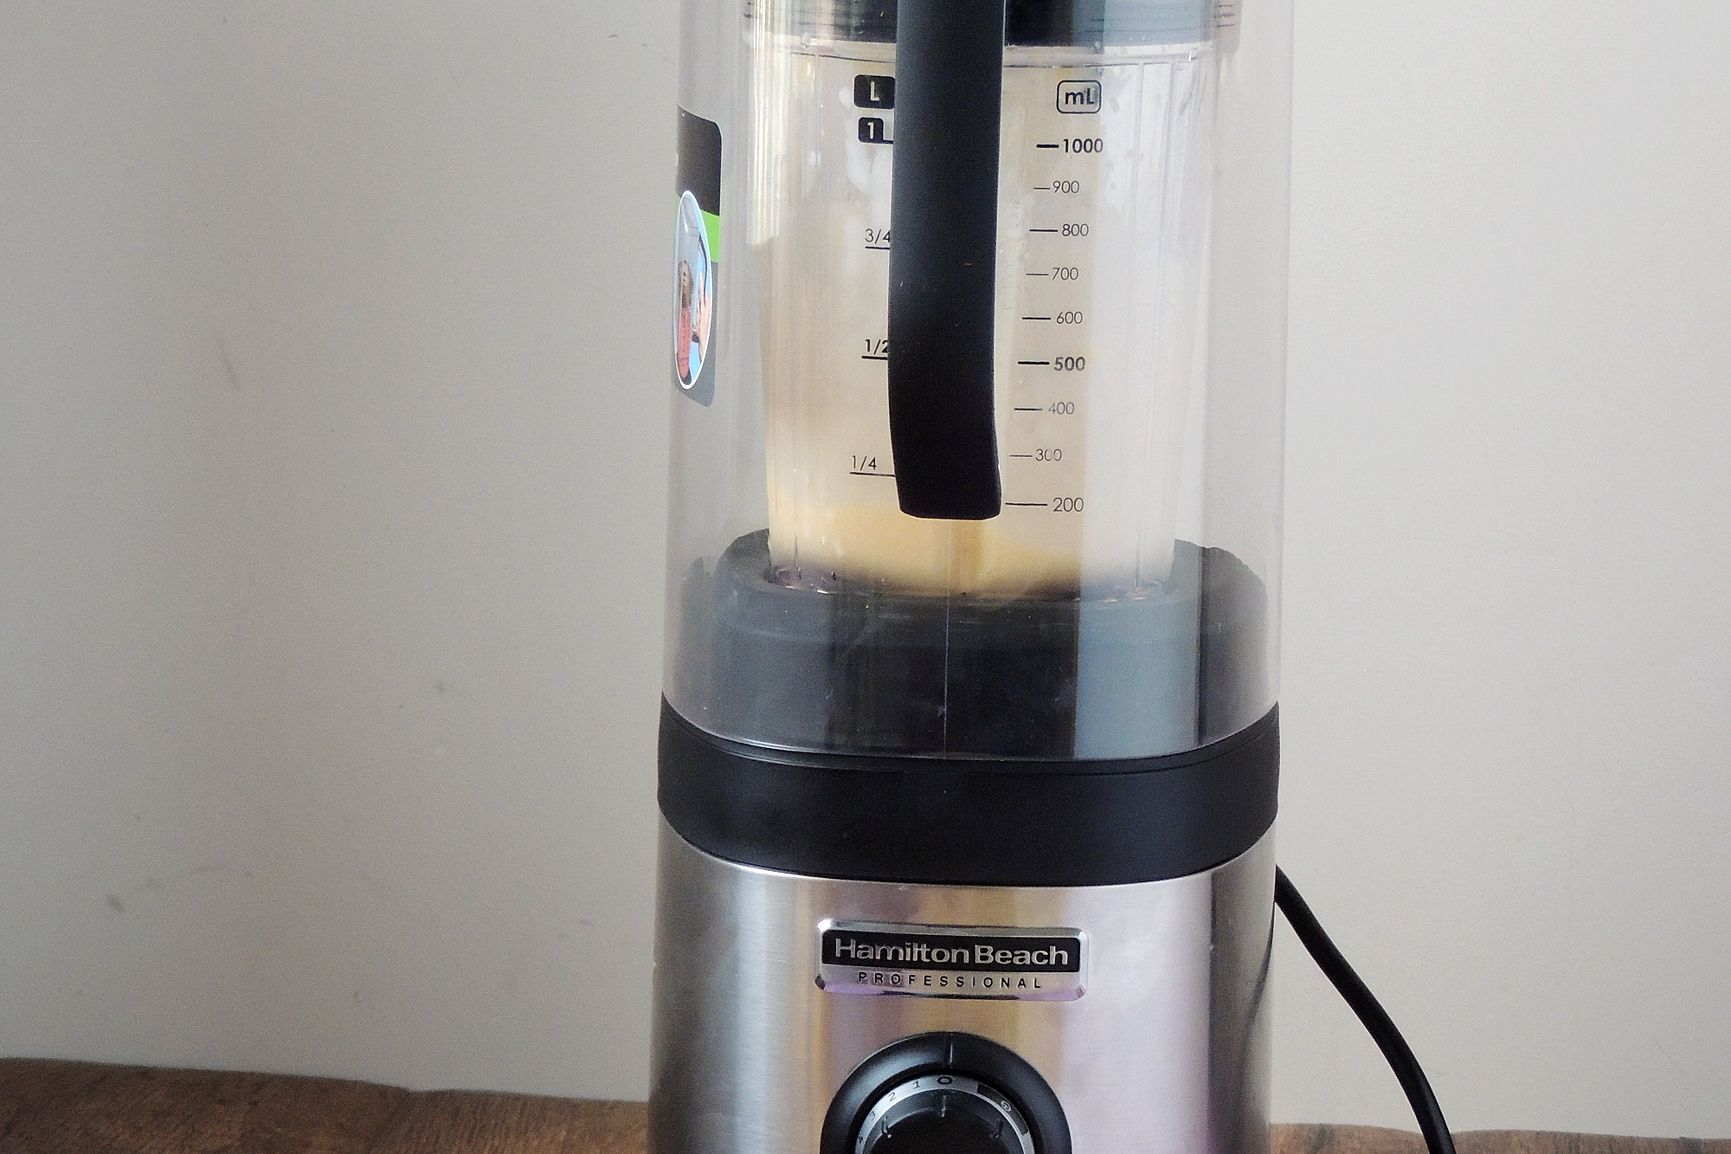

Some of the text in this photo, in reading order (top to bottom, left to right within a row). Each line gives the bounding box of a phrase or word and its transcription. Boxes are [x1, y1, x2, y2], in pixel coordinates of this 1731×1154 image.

[870, 81, 880, 101] L
[1064, 87, 1095, 105] mL
[1063, 138, 1104, 154] 1000
[1052, 180, 1080, 194] 900
[1061, 223, 1089, 237] 800
[1052, 267, 1079, 281] 700
[1056, 311, 1083, 325] 600
[1053, 356, 1086, 372] 500
[1048, 401, 1075, 415] 400
[1035, 448, 1063, 462] 300
[852, 455, 877, 471] 1/4
[1053, 497, 1084, 512] 200
[835, 937, 1068, 966] Hamilton Beach
[858, 971, 1041, 989] PROFESSIONAL
